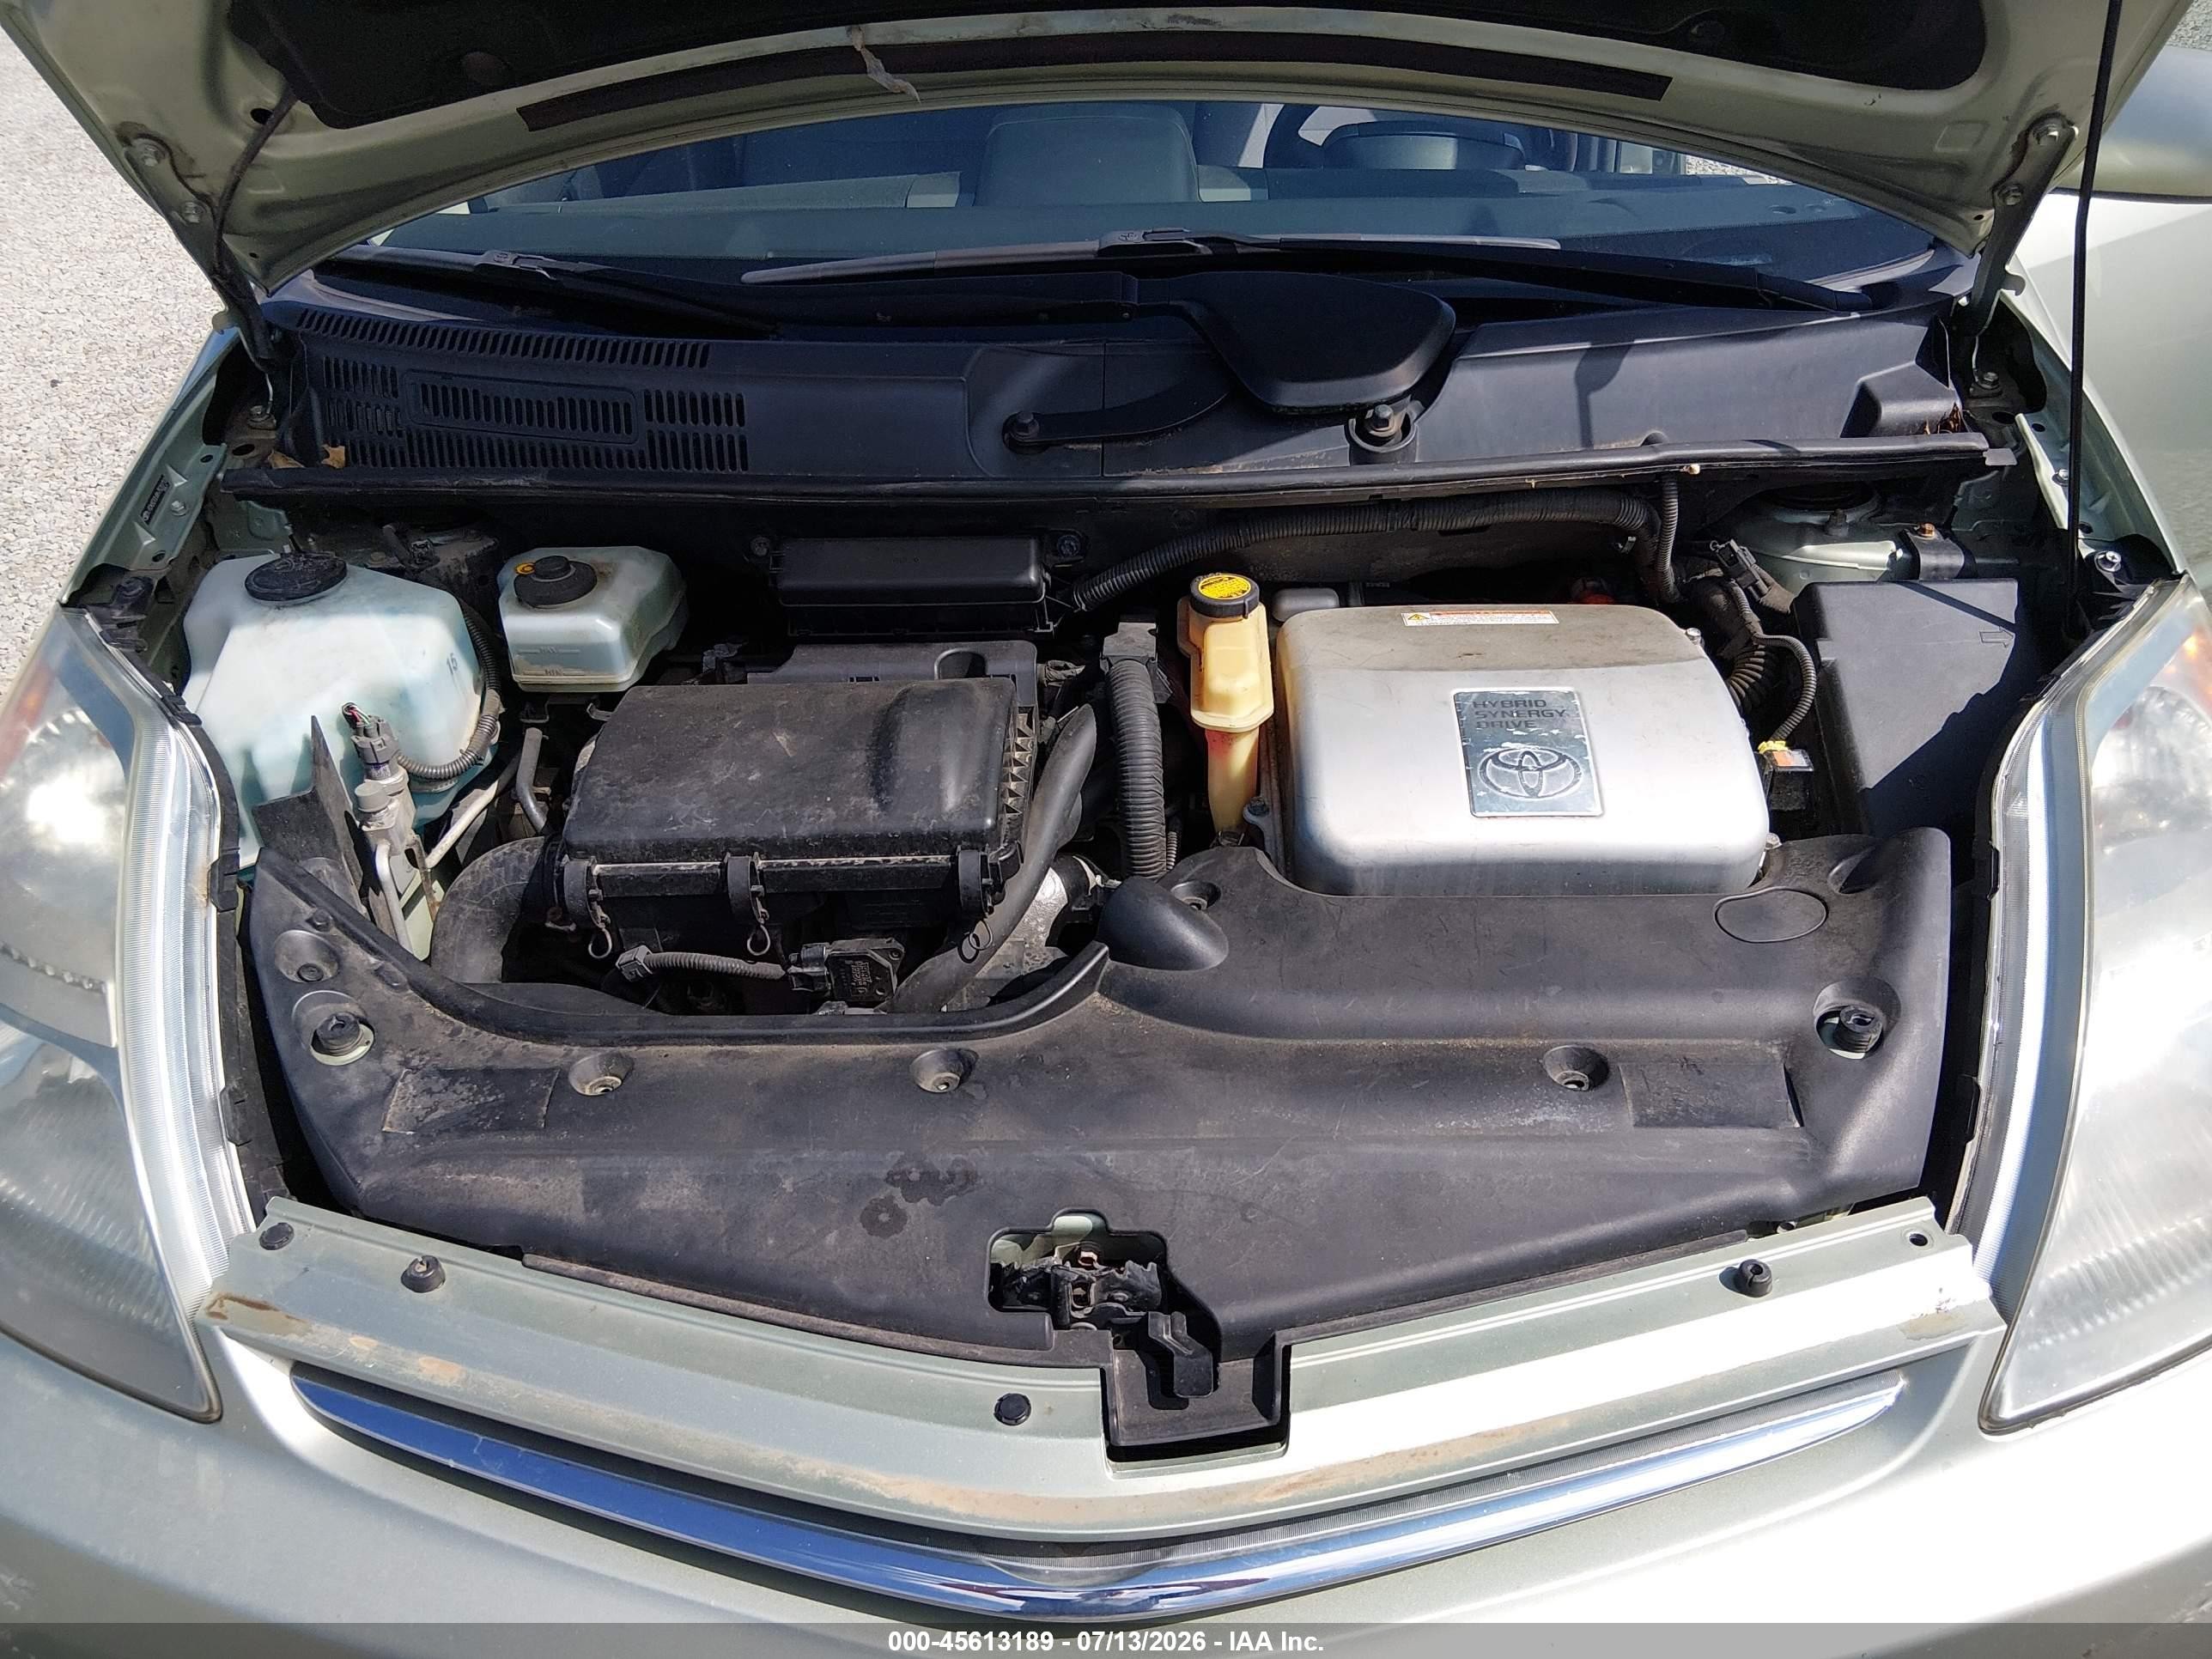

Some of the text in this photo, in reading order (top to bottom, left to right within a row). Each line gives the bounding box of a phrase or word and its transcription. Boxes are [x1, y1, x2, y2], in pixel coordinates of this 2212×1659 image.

[1473, 699, 1547, 708] HYBRID
[1474, 708, 1566, 719] SYNERGY
[1476, 719, 1537, 729] DRIVE
